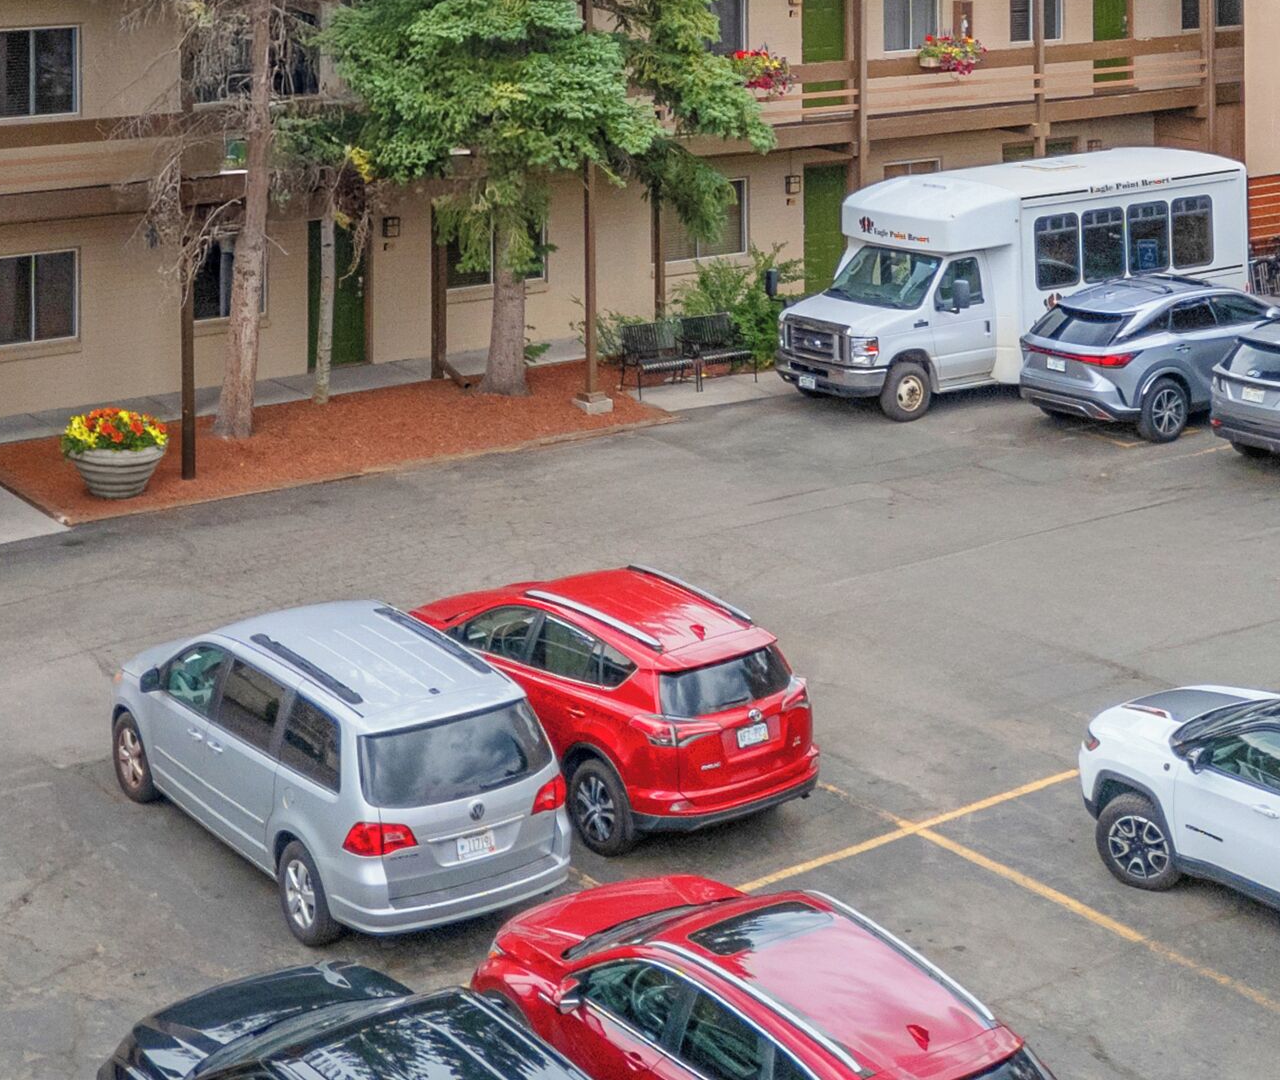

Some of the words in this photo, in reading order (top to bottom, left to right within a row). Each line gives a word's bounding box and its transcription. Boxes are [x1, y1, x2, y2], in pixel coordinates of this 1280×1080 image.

[1089, 184, 1114, 194] Eagle
[1116, 181, 1140, 190] Point
[1141, 177, 1170, 187] Resort
